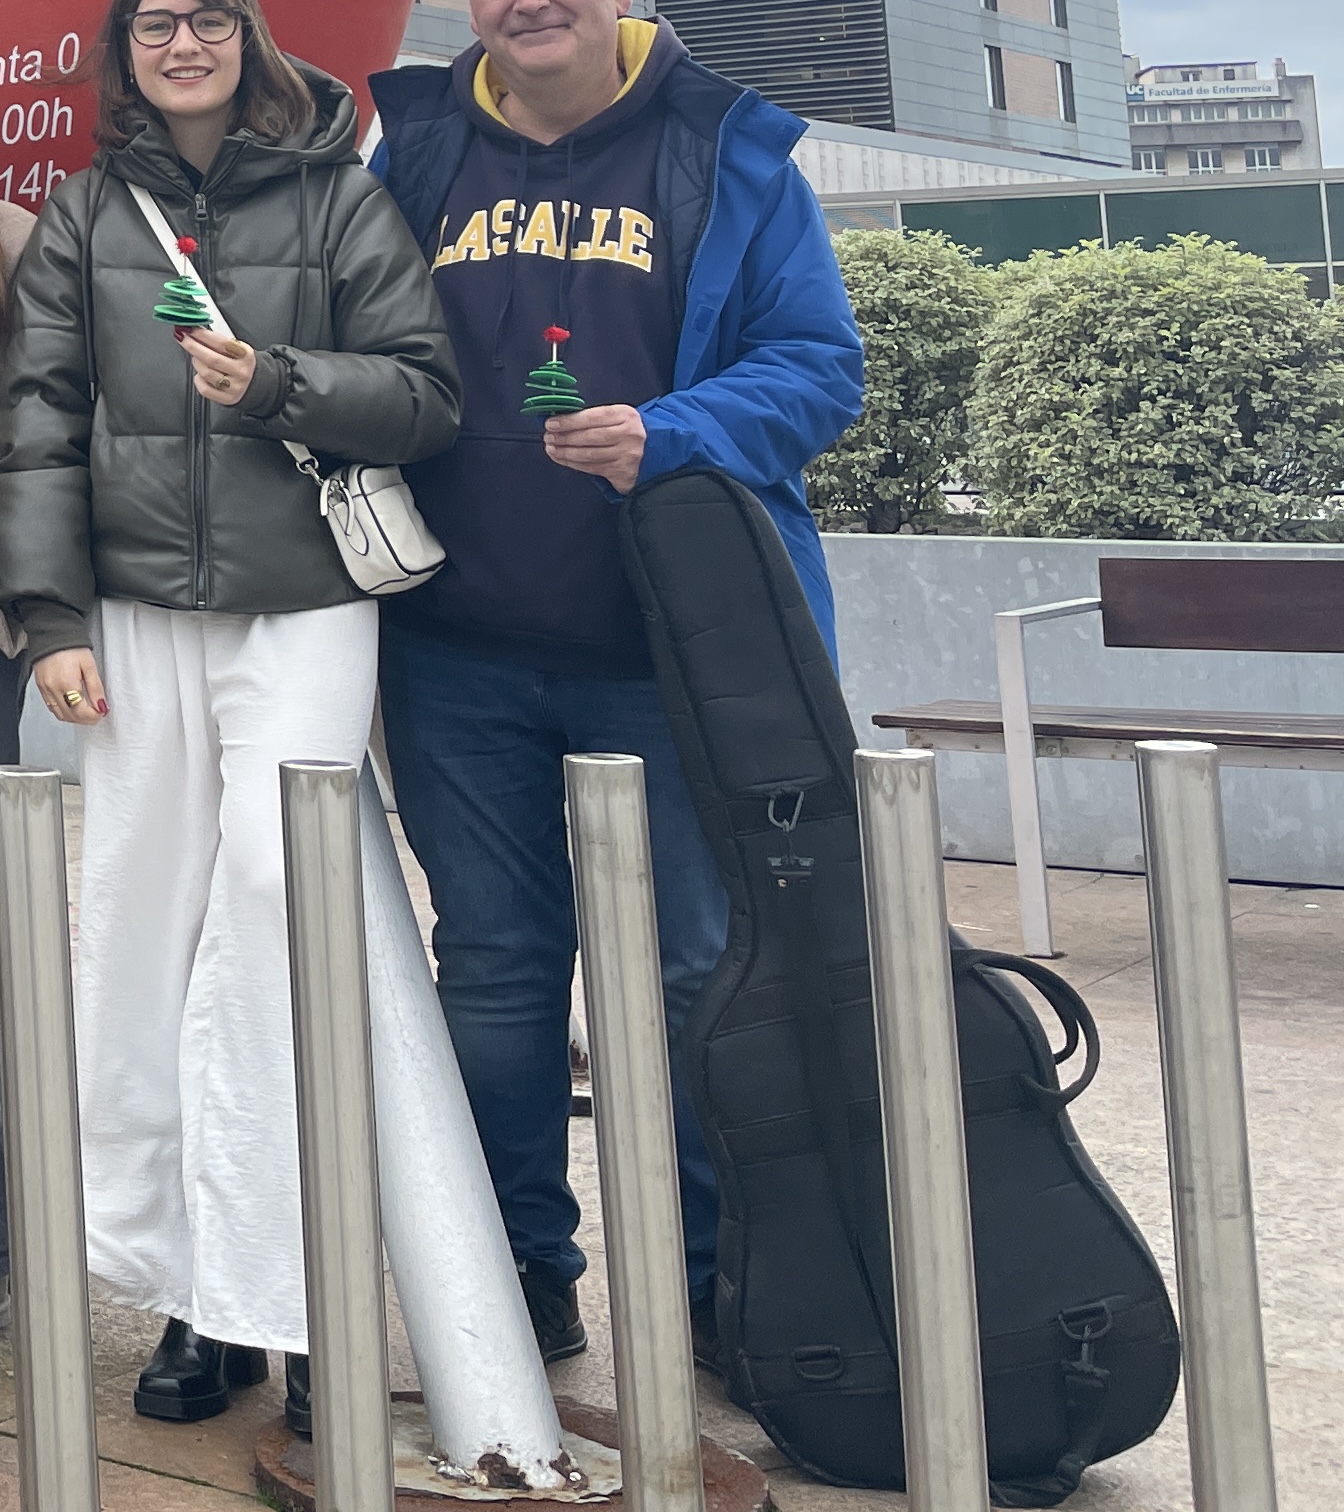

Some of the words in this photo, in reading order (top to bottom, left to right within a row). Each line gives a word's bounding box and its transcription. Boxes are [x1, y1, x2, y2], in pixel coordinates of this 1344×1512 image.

[57, 31, 81, 75] 0
[1148, 86, 1193, 97] Facultad
[1196, 85, 1210, 95] de
[1212, 84, 1272, 95] Enfermería
